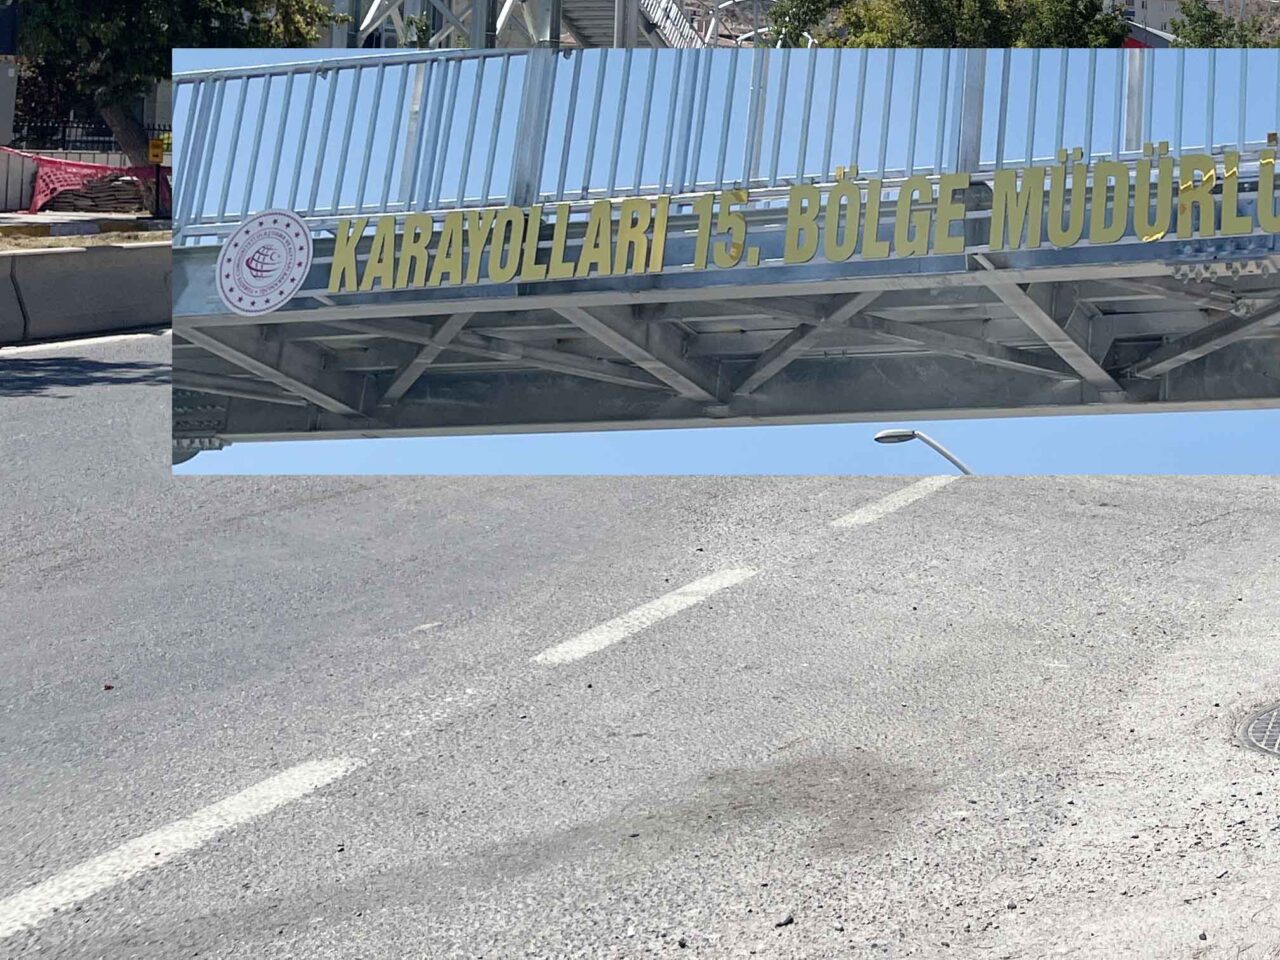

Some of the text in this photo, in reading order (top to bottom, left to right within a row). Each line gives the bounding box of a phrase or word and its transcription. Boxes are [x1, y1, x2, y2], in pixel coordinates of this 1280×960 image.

[328, 196, 671, 292] KARAYOLLARI
[692, 189, 761, 270] 15.
[783, 164, 971, 264] BÖLGE
